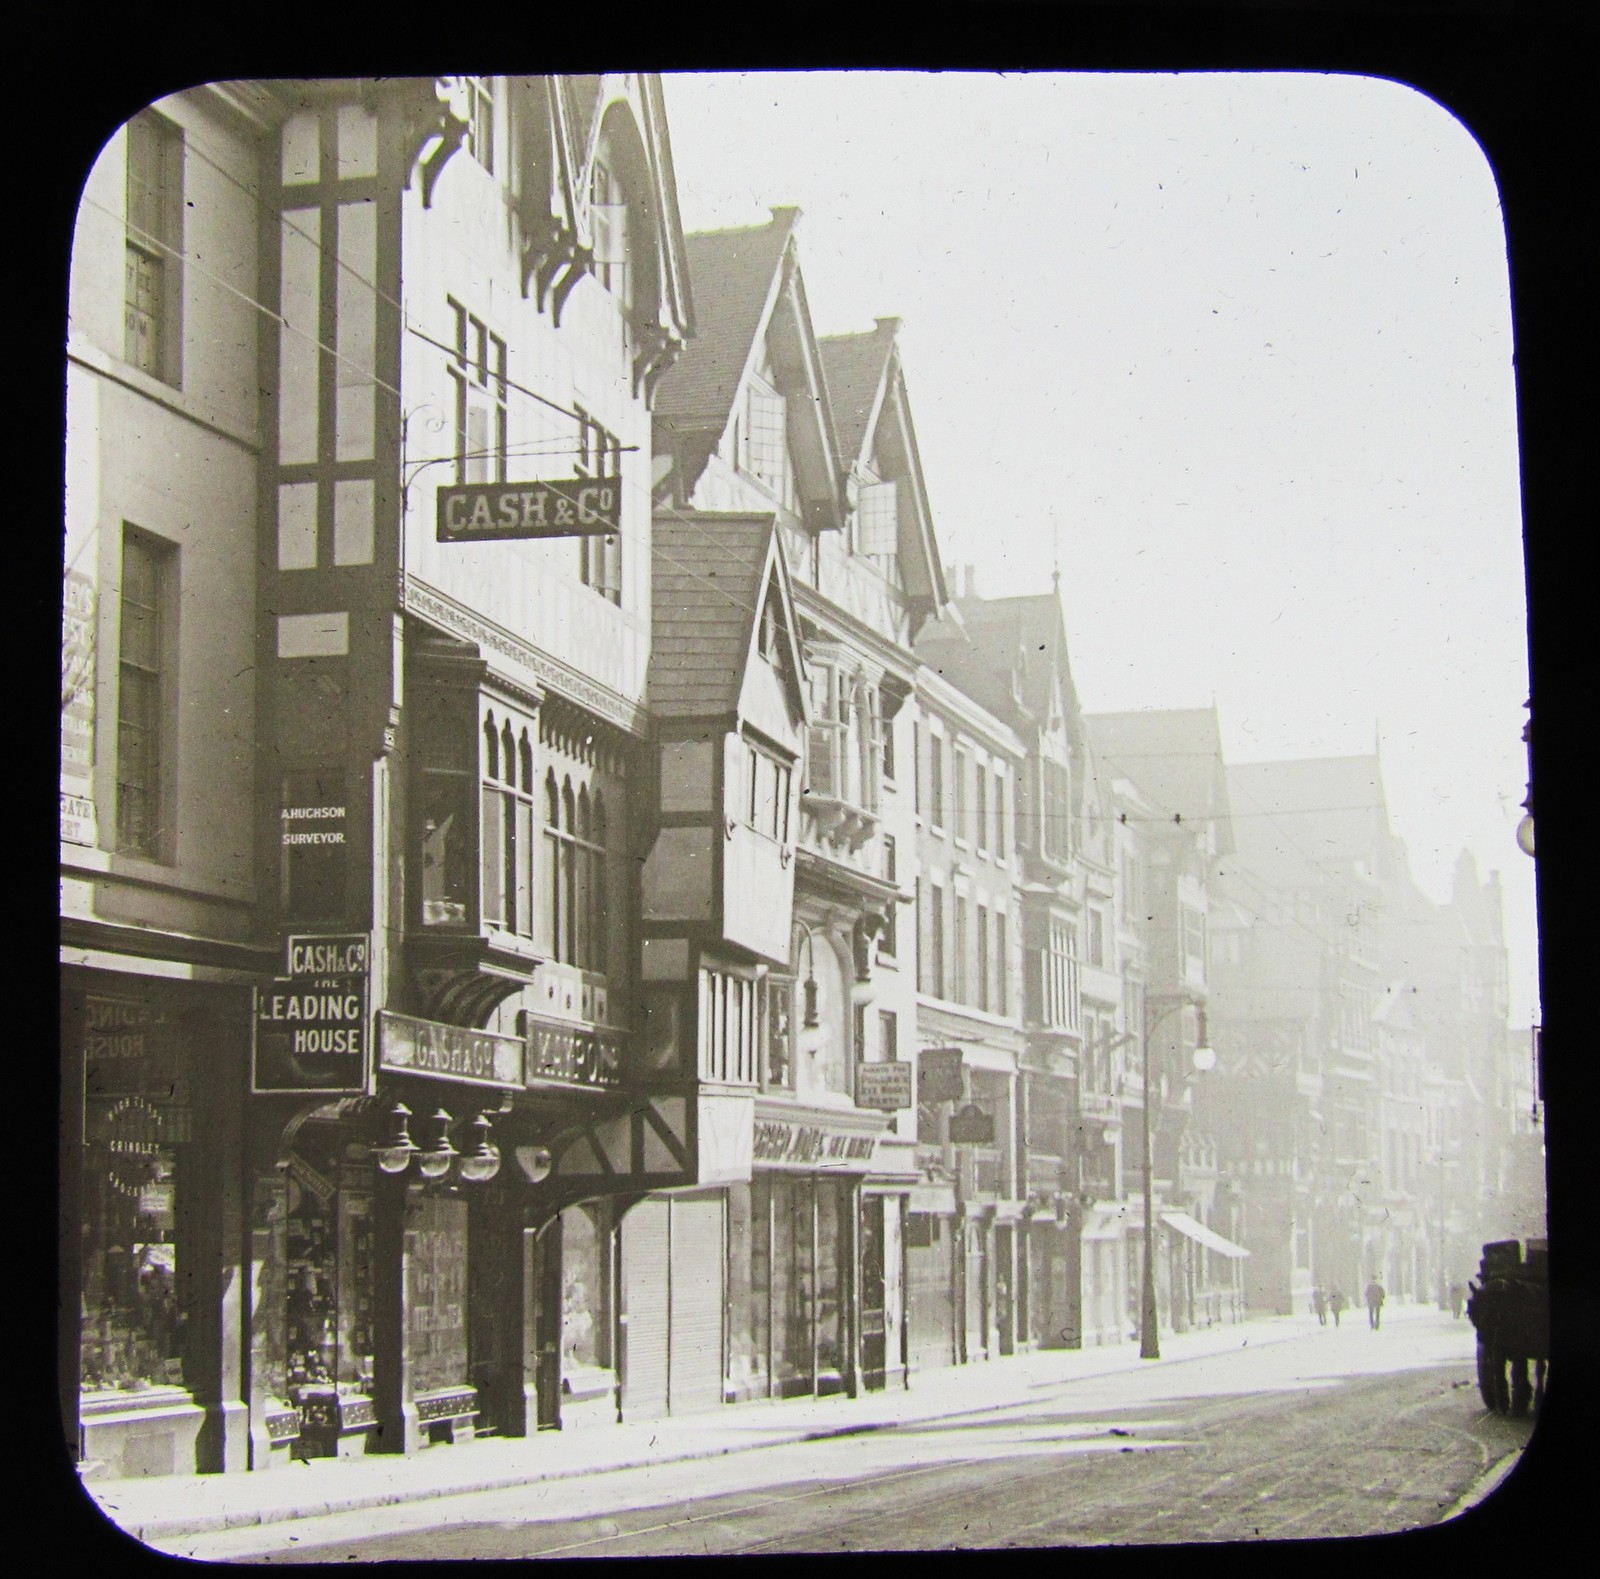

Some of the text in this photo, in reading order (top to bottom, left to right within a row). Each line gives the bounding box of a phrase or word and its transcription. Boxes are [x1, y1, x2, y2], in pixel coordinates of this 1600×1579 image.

[446, 491, 549, 531] CASH
[554, 498, 575, 526] &
[293, 945, 338, 973] CASH
[338, 957, 346, 973] &
[260, 995, 360, 1020] LEADING
[294, 1029, 360, 1053] HOUSE
